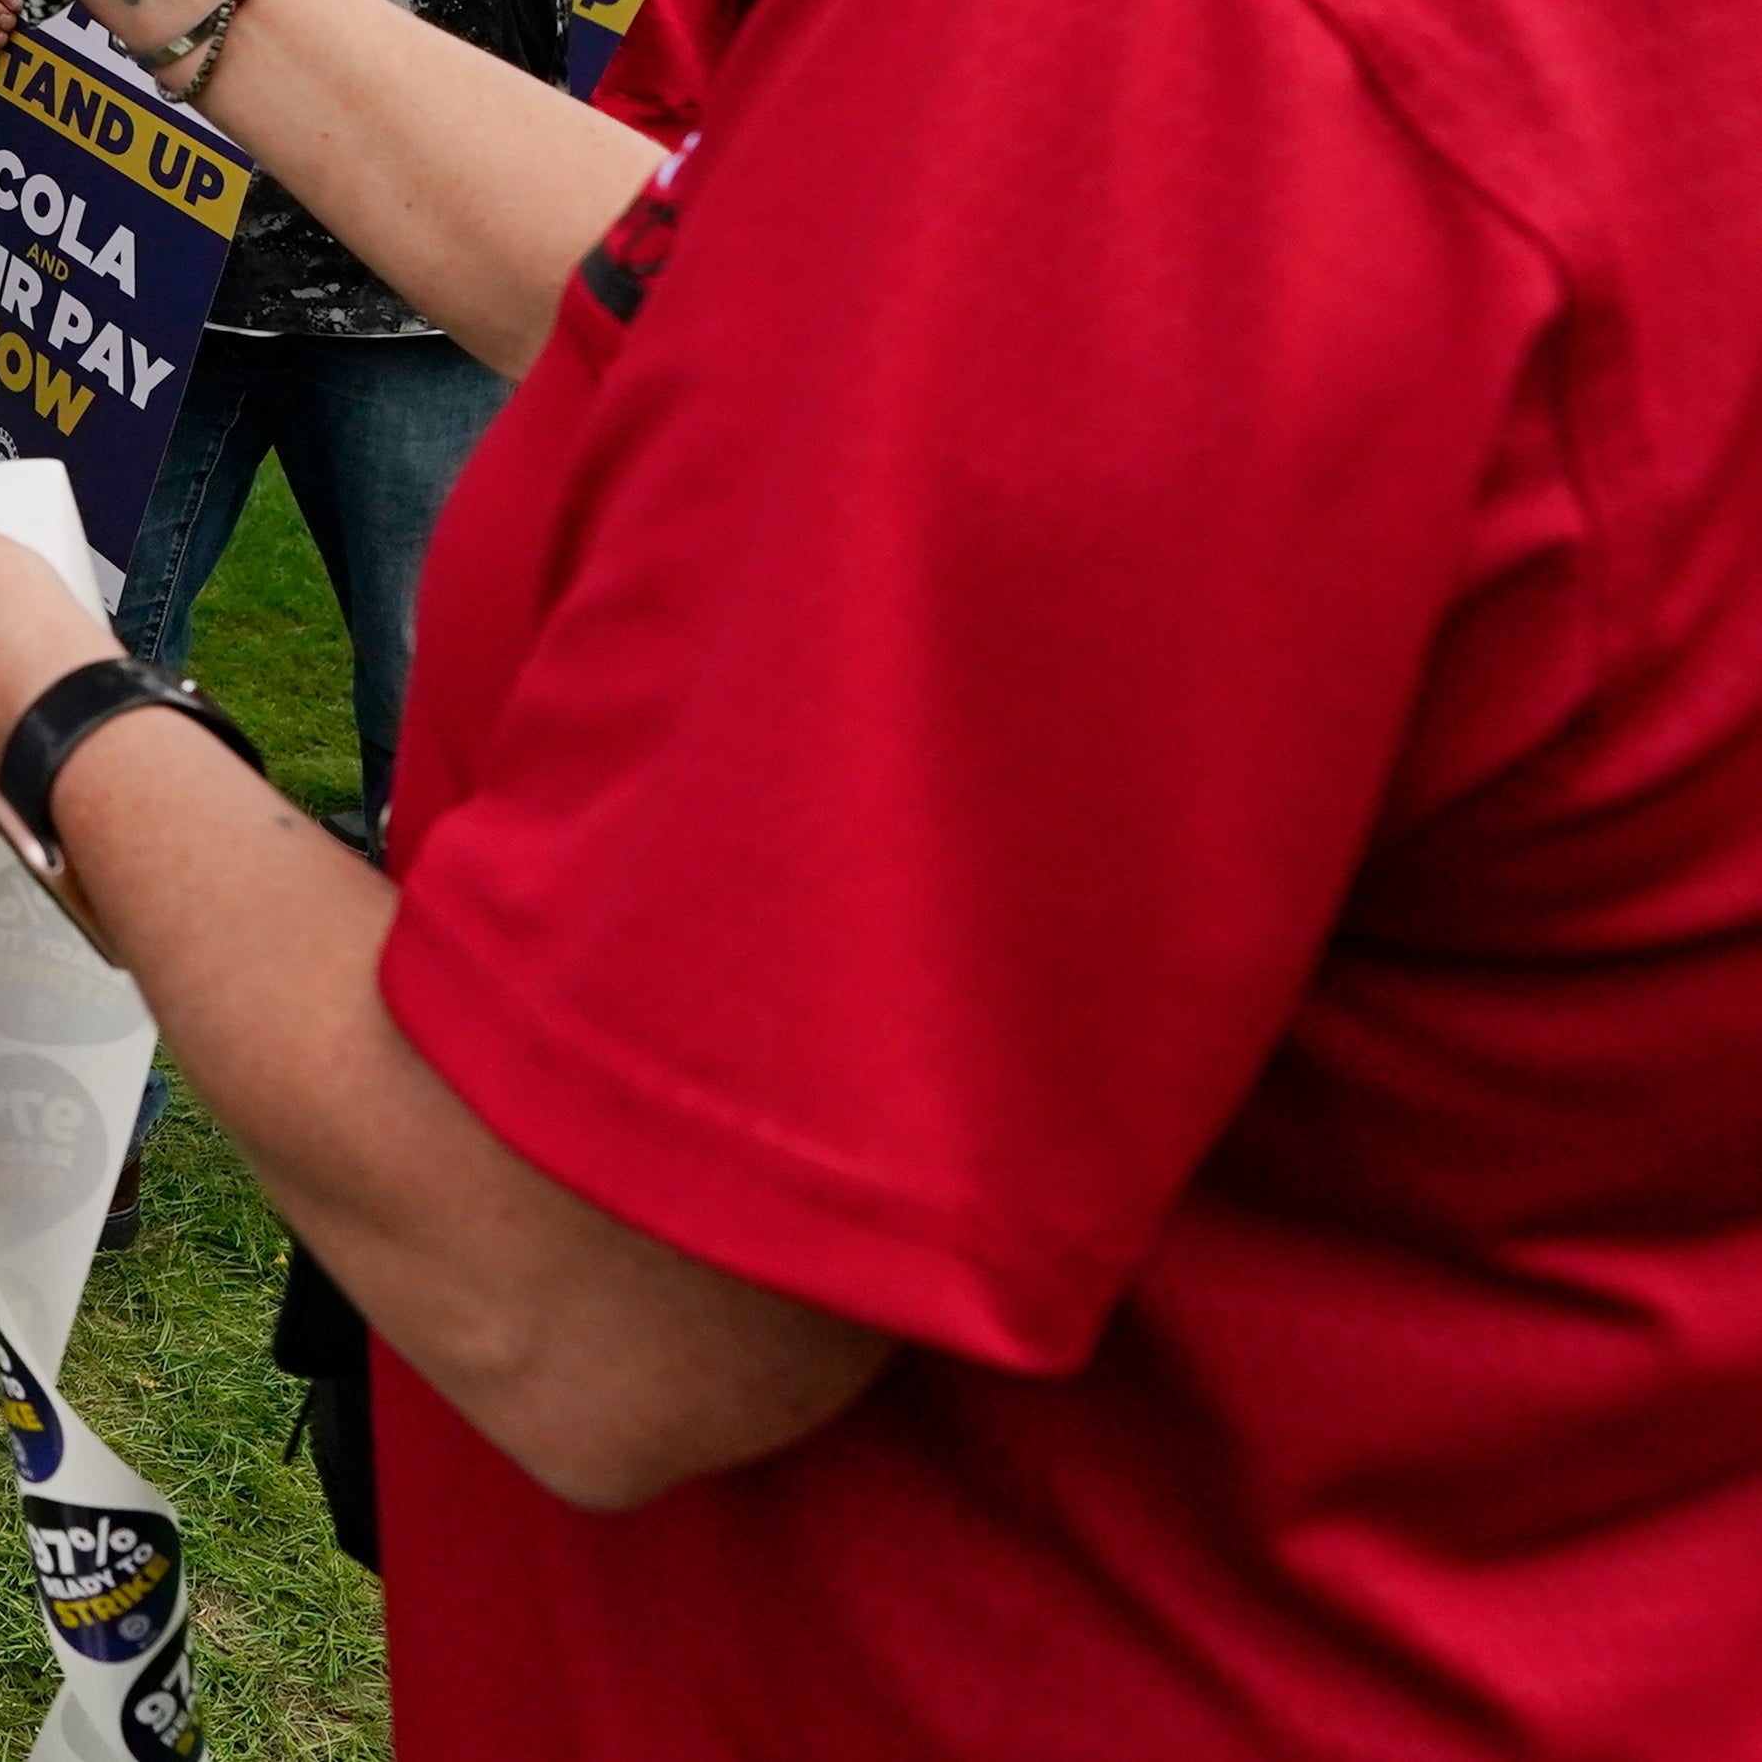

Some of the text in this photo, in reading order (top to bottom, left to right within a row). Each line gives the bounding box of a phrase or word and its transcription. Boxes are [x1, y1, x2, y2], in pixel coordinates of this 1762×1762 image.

[148, 131, 225, 207] UP
[26, 242, 70, 281] AND
[47, 289, 176, 411] PAY
[115, 1541, 154, 1575] TO
